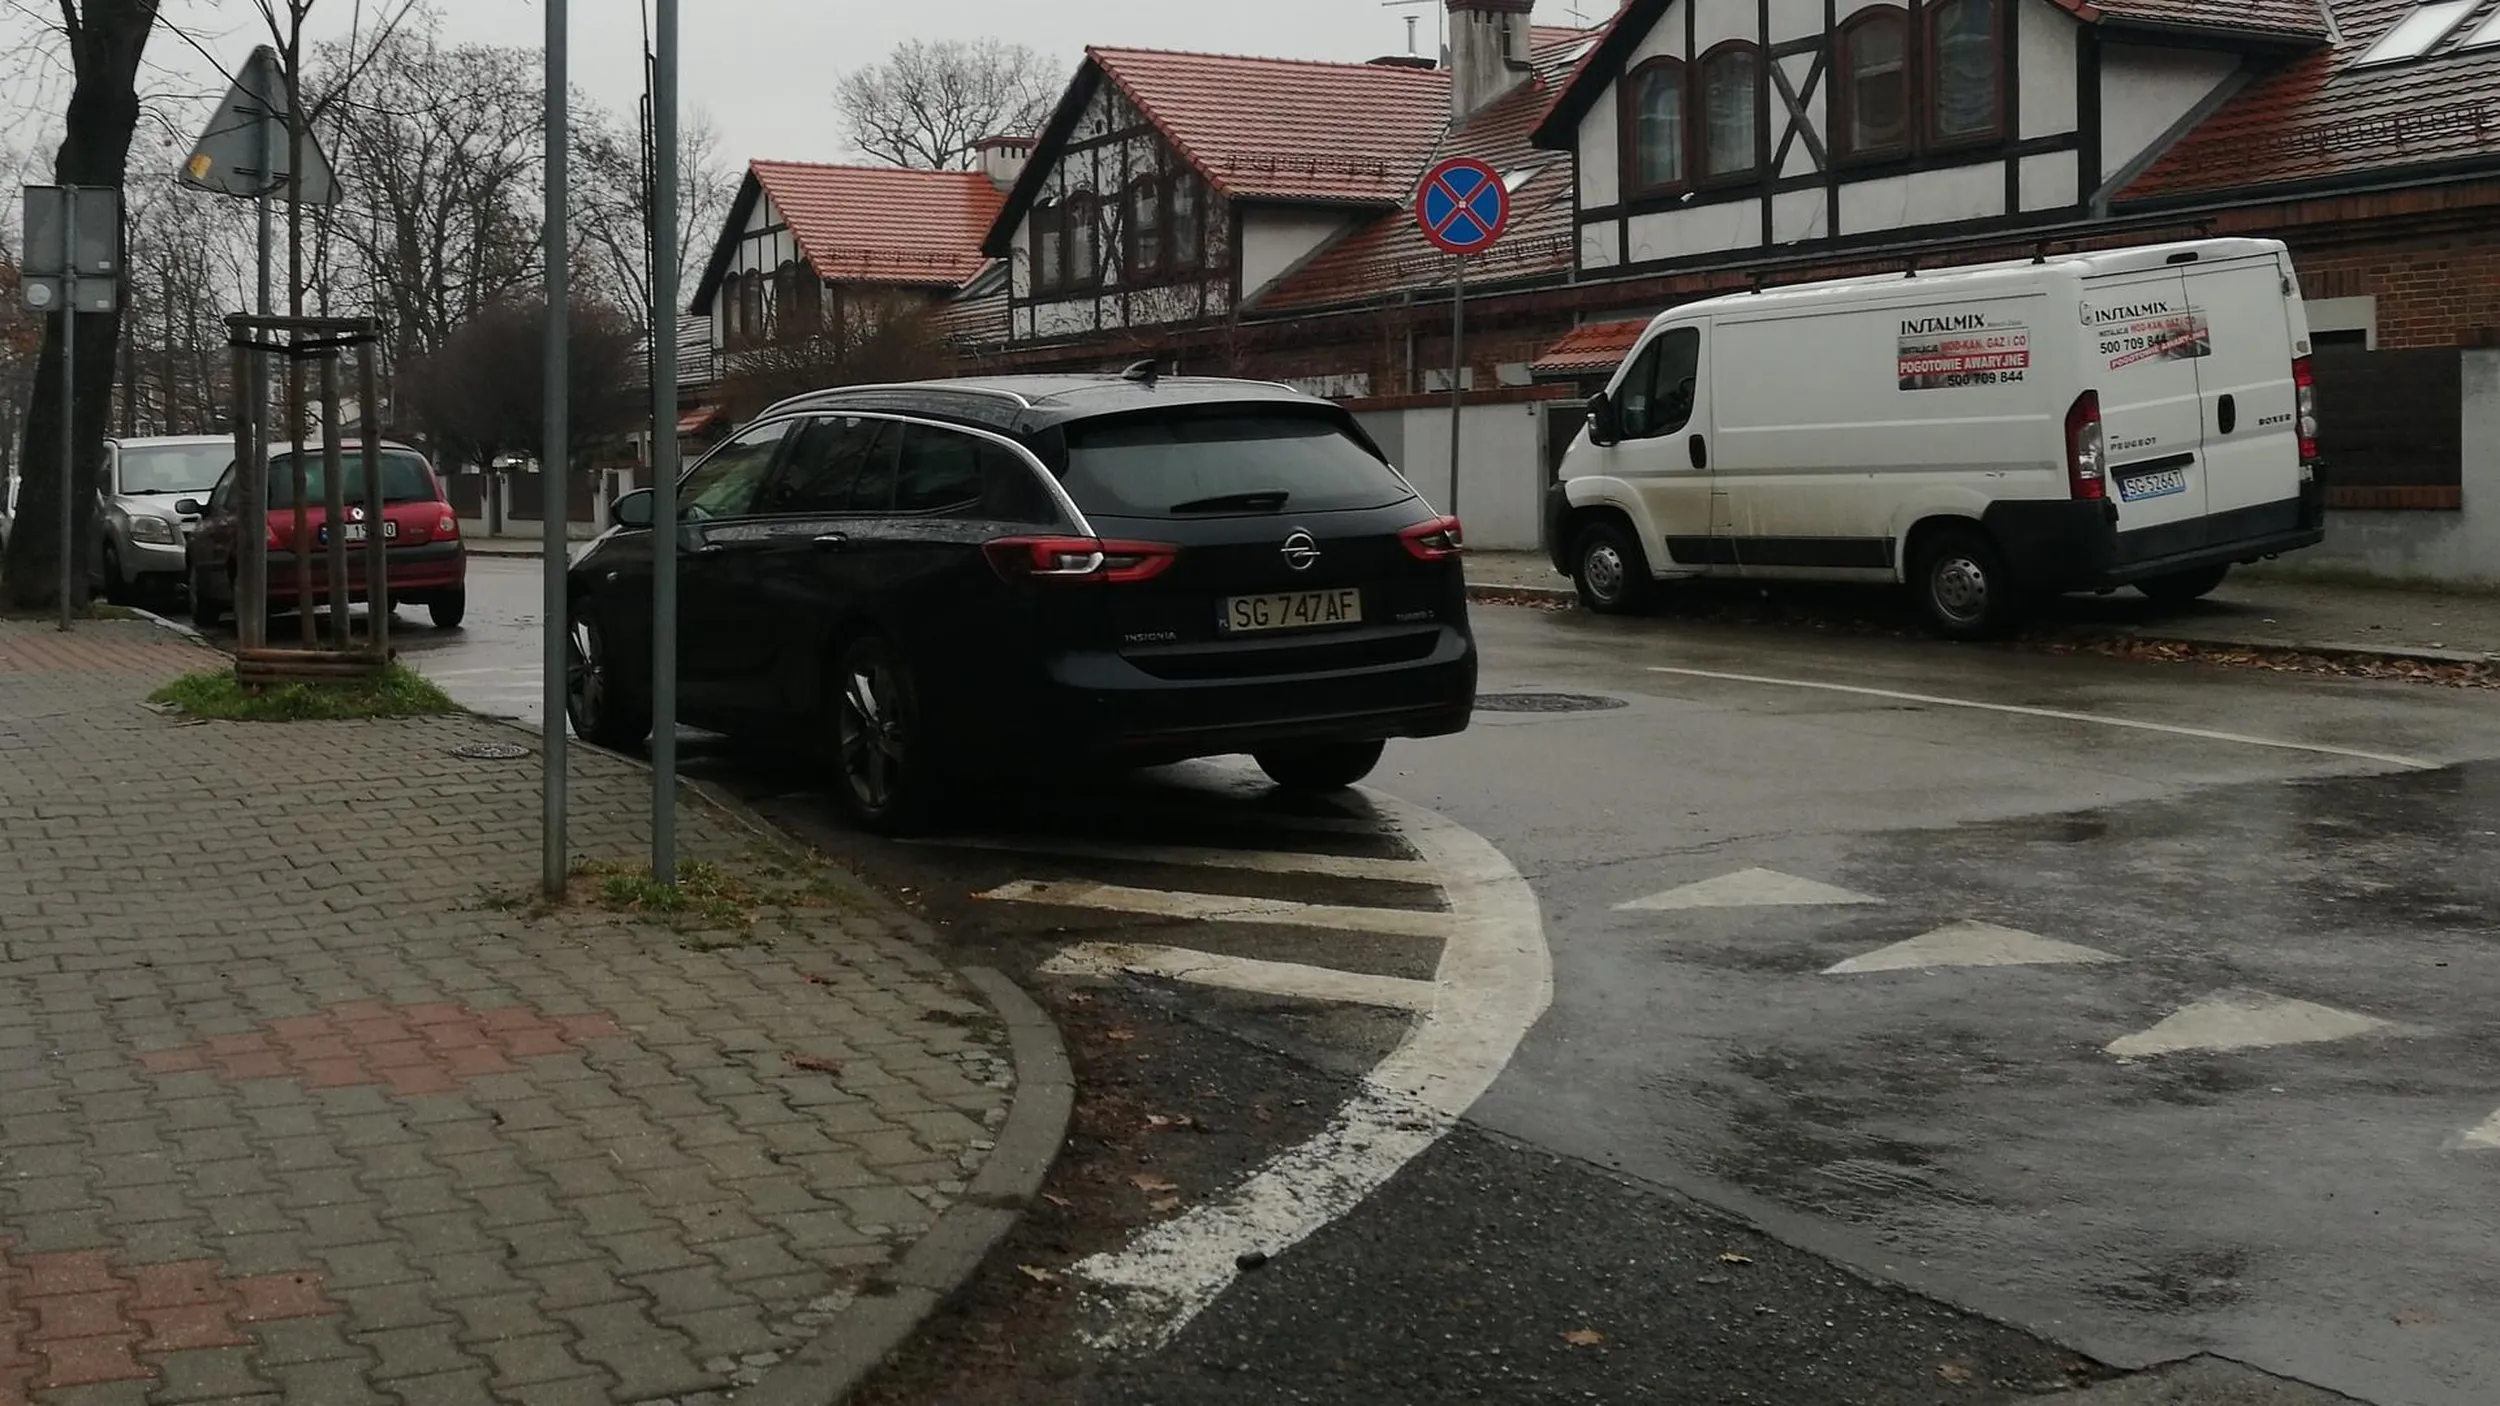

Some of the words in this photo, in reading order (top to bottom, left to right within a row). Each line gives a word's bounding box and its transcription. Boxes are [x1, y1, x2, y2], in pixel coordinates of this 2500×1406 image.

[2095, 301, 2168, 322] INSTALMIX
[1901, 313, 1985, 335] INSTALMIX
[1987, 337, 2004, 348] GAZ
[2013, 335, 2026, 346] CO
[2100, 341, 2120, 354] 500
[2124, 337, 2144, 350] 709
[2146, 333, 2167, 347] 844
[1900, 357, 1963, 374] POGOTOWIE
[1964, 353, 2025, 369] AWARYJNE
[1948, 373, 1970, 387] 500
[1975, 372, 1996, 384] 709
[2001, 371, 2024, 383] 844
[2258, 413, 2291, 426] BOXER
[2110, 437, 2156, 450] PEUGEOT
[2127, 477, 2144, 495] SG
[2146, 471, 2180, 492] 5266T
[1235, 599, 1268, 627] SG
[1278, 591, 1353, 625] 747AF
